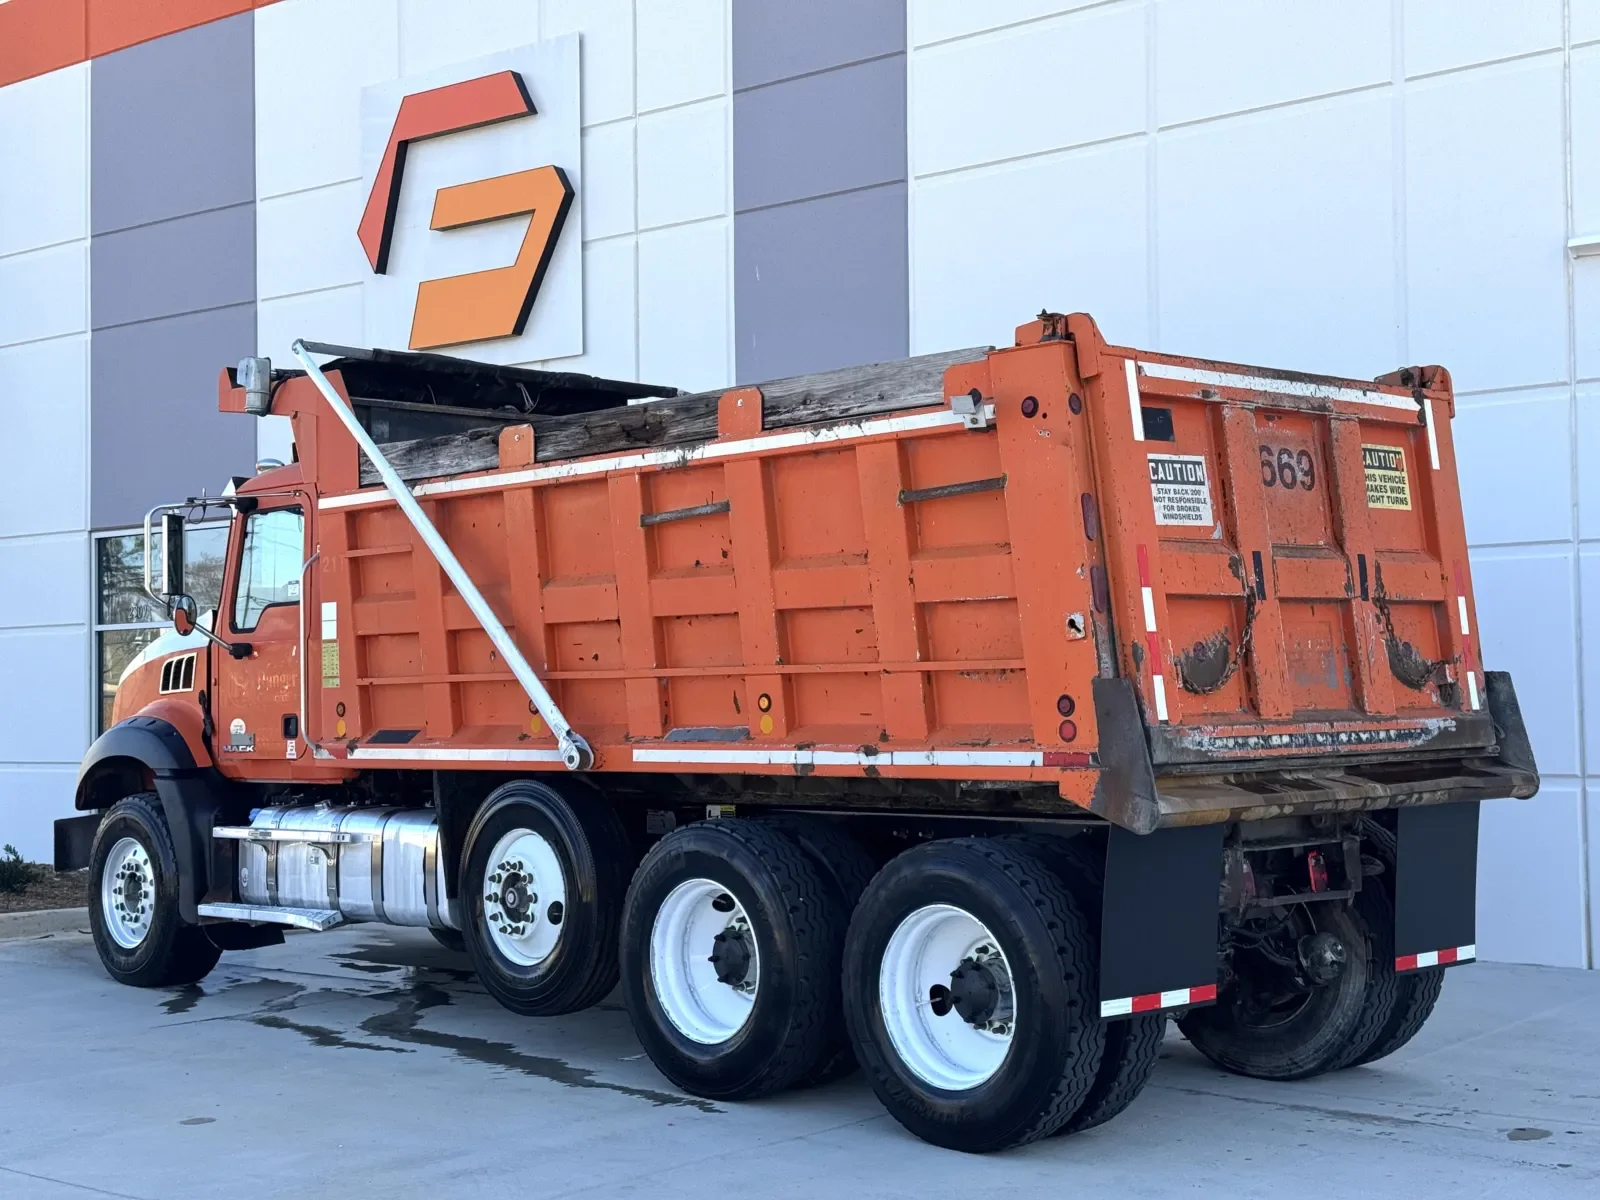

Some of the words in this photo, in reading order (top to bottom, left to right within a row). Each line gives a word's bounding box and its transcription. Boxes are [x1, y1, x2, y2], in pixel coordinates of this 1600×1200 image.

[1148, 462, 1204, 482] CAUTION
[1259, 444, 1316, 491] 669
[1364, 473, 1377, 483] HIS
[1378, 474, 1407, 485] VEHICLE
[1157, 488, 1171, 496] STAY
[1173, 488, 1190, 496] BACK
[1389, 485, 1406, 495] WIDE
[1154, 496, 1166, 504] NOT
[1167, 496, 1208, 505] RESPONSIBLE
[1367, 495, 1385, 504] IGHT
[1387, 496, 1409, 506] TURNS
[1177, 505, 1201, 513] BROKEN
[1163, 513, 1203, 521] WINDSHIELDS
